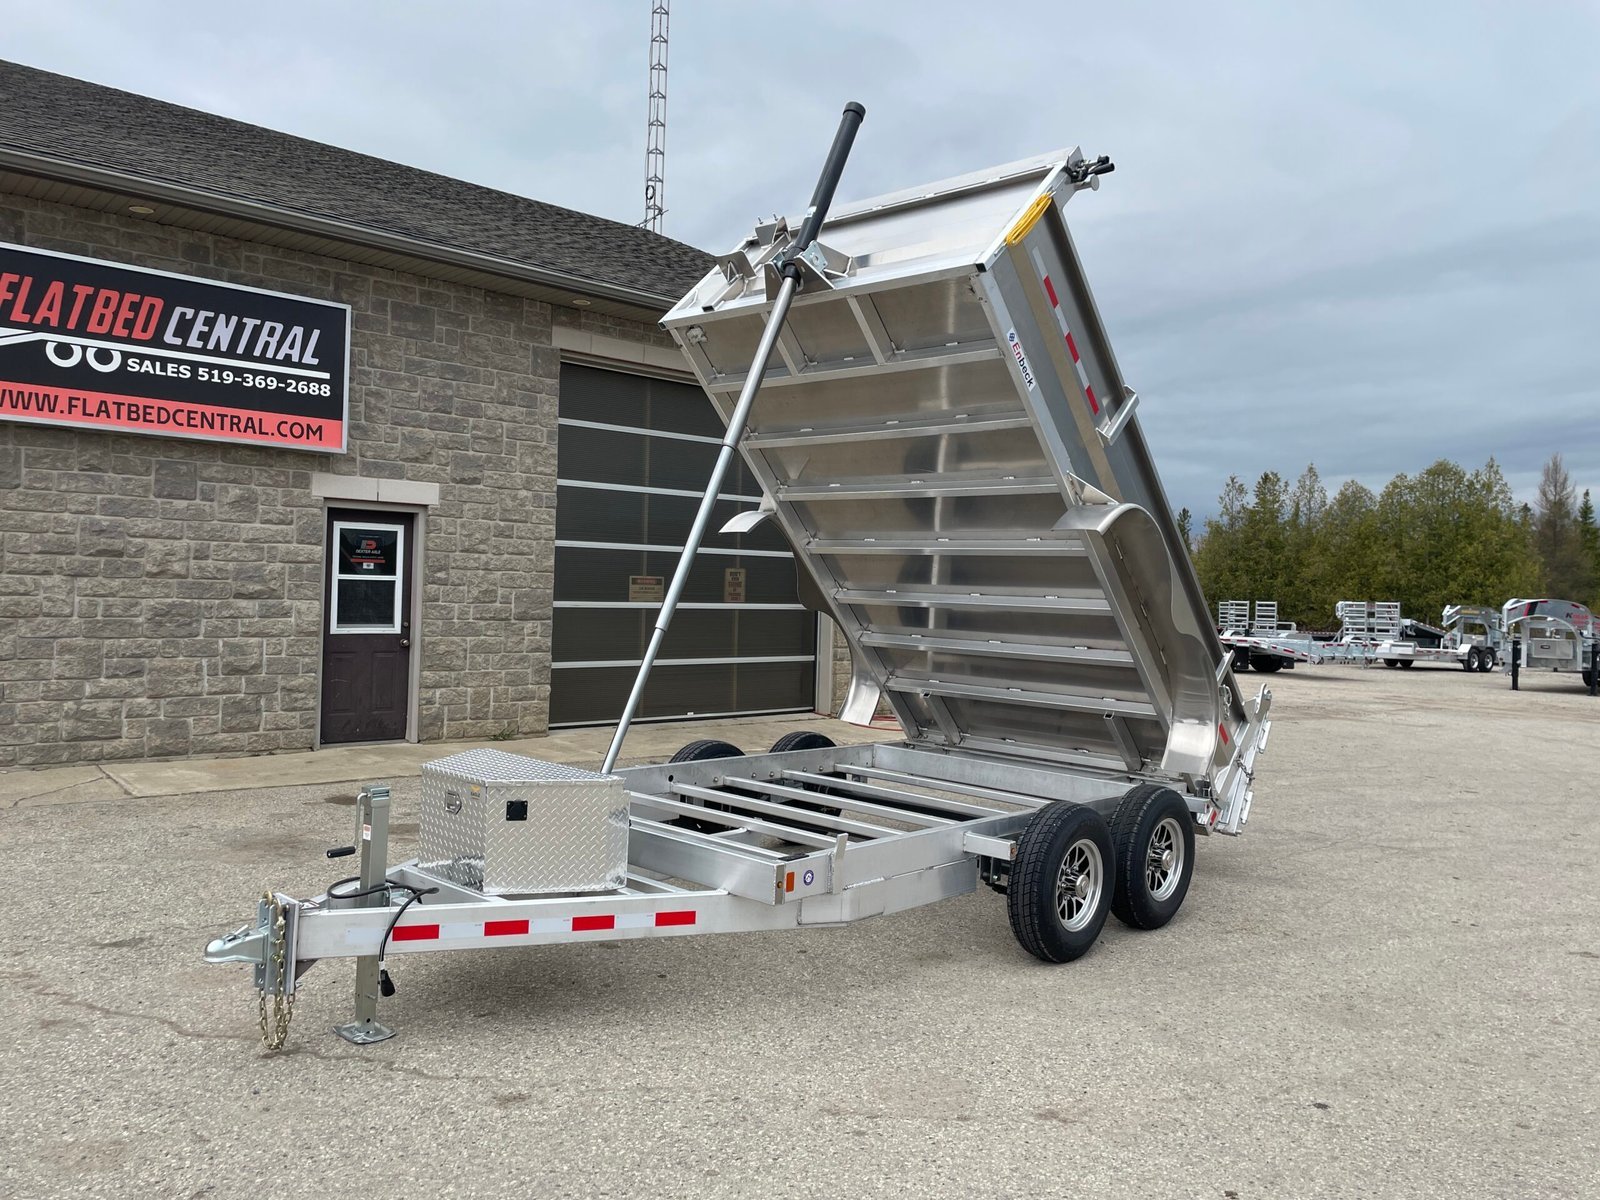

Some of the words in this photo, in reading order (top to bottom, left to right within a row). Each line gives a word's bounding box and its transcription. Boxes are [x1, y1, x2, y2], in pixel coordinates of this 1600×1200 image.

[0, 272, 165, 341] FLATBED
[163, 306, 321, 365] CENTRAL
[126, 358, 191, 378] SALES
[197, 367, 331, 397] 519-369-2688
[1012, 342, 1034, 388] Enbeck
[0, 388, 323, 441] WW.FLATBEDCENTRAL.COM
